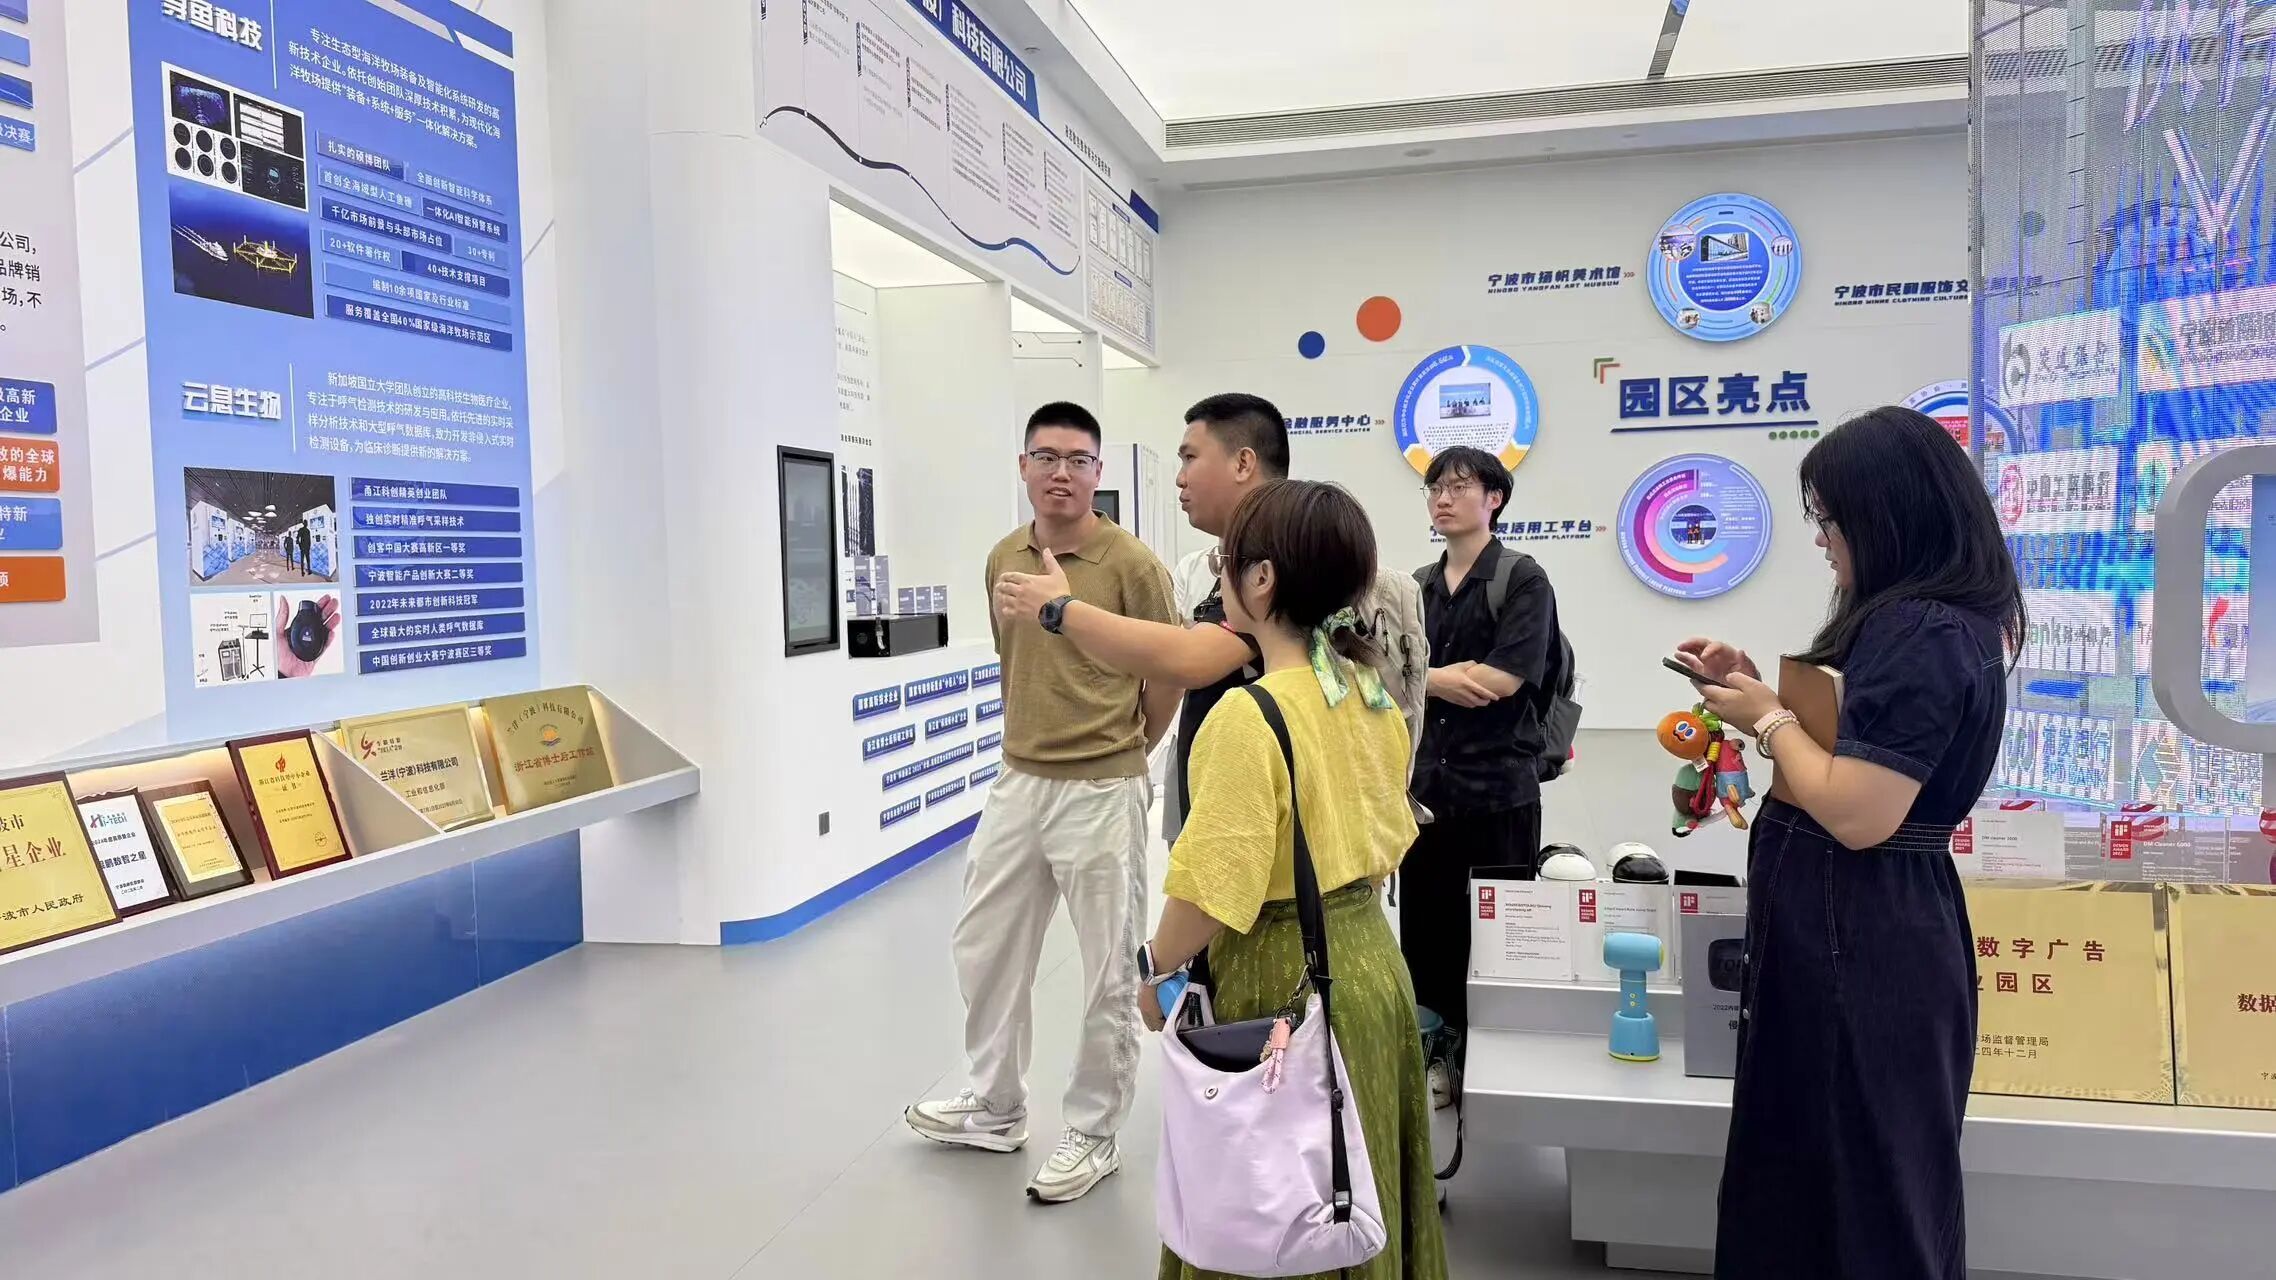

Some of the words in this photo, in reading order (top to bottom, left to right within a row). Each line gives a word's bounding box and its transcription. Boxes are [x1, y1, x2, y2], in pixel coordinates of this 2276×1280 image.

[310, 27, 500, 120] 专注生态型海洋牧场装备及智能化系统研发的高
[288, 41, 501, 139] 新技术企业。依托创始团队深厚技术积累，为现代化海
[0, 122, 31, 143] 决赛
[328, 140, 391, 171] 扎实的硕博团队
[332, 206, 443, 247] 千亿市场前景与头部市场占位
[427, 206, 501, 236] 一体化AI智能预警系统
[330, 238, 391, 263] 20+软件著作权
[467, 246, 496, 262] 30+专利
[428, 263, 486, 287] 40+技术支撑项目
[1488, 266, 1621, 287] 宁波市扬帆美术馆
[1523, 284, 1560, 292] YANGFAN
[1584, 280, 1619, 288] MUSEUM
[372, 278, 470, 311] 编制10余项国家及行业标准
[345, 304, 491, 344] 服务覆盖全国40%国家级海洋牧场示范区
[182, 382, 282, 420] 云息生物
[327, 371, 512, 411] 新加坡国立大学团队创立的高科技生物医疗企业，
[1620, 370, 1811, 419] 园区亮点
[0, 406, 29, 423] 企业
[307, 391, 514, 429] 专注于呼气检测技术的研发与应用。依托先进的实时采
[1281, 414, 1371, 429] 金融服务中心
[309, 436, 471, 463] 检测设备，为临床诊断提供新的解决方案。
[3, 465, 48, 482] 爆能力
[364, 485, 448, 500] 甬江科创精英创业团队
[366, 513, 465, 528] 独创实时精准呼气采样技术
[367, 541, 466, 554] 创客中国大赛高新区一等奖
[368, 568, 474, 582] 宁波智能产品创新大赛二等奖
[370, 594, 479, 609] 2022年未来都市创新科技冠军
[371, 620, 484, 639] 全球最大的实时人类呼气数据库
[372, 645, 492, 667] 中国创新创业大赛宁波赛区三等奖
[380, 757, 459, 781] 兰洋(宁波)科技有限公司
[514, 747, 595, 772] 浙江省博士后工作站
[405, 782, 446, 798] 工业和信息化部
[4, 836, 66, 868] 星企业
[2, 893, 84, 921] 波市人民政府
[1977, 936, 2106, 962] 数字广告
[2237, 993, 2276, 1013] 数据
[1976, 1034, 2049, 1047] 场监督管理局
